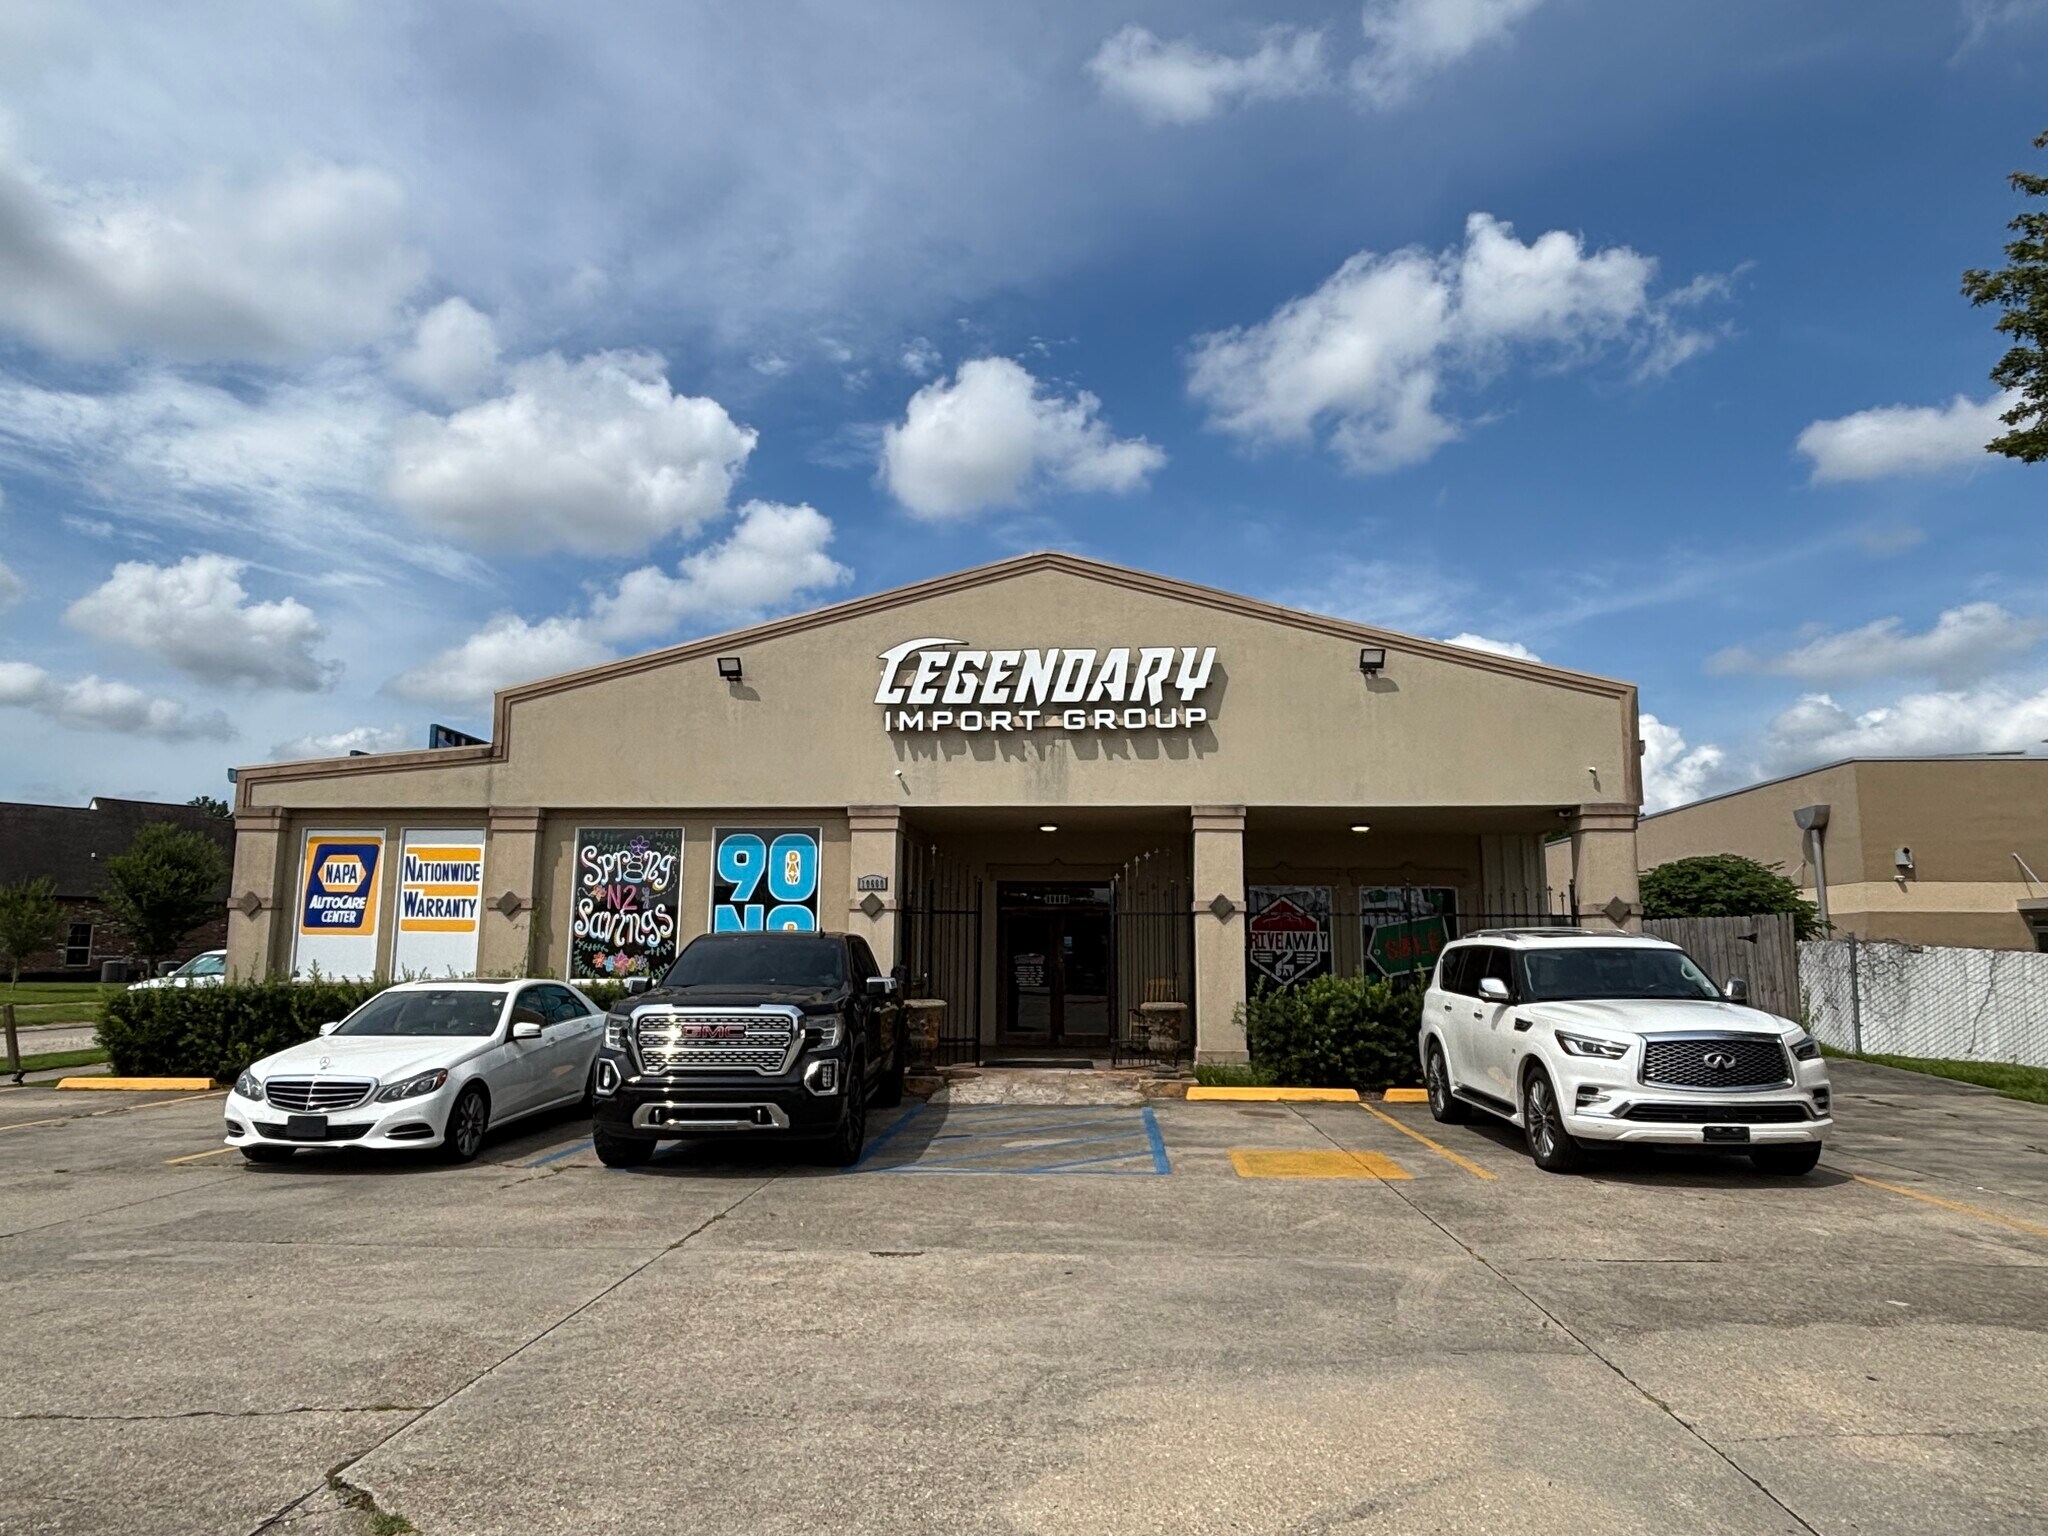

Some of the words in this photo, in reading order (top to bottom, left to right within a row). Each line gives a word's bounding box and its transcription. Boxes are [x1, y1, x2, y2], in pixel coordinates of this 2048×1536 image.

[874, 637, 1217, 706] LEGENDARY
[885, 709, 1040, 732] IMPORT
[1063, 707, 1207, 731] GROUP
[324, 863, 358, 884] NAPA
[403, 855, 481, 883] NATIONWIDE
[717, 833, 818, 901] 90
[403, 890, 477, 918] WARRANTY
[606, 884, 638, 910] N2
[321, 910, 356, 924] CENTER
[574, 898, 675, 947] Savings
[1248, 931, 1328, 950] RIVEAWAY
[1275, 967, 1296, 977] DAY
[683, 1025, 745, 1038] GMC
